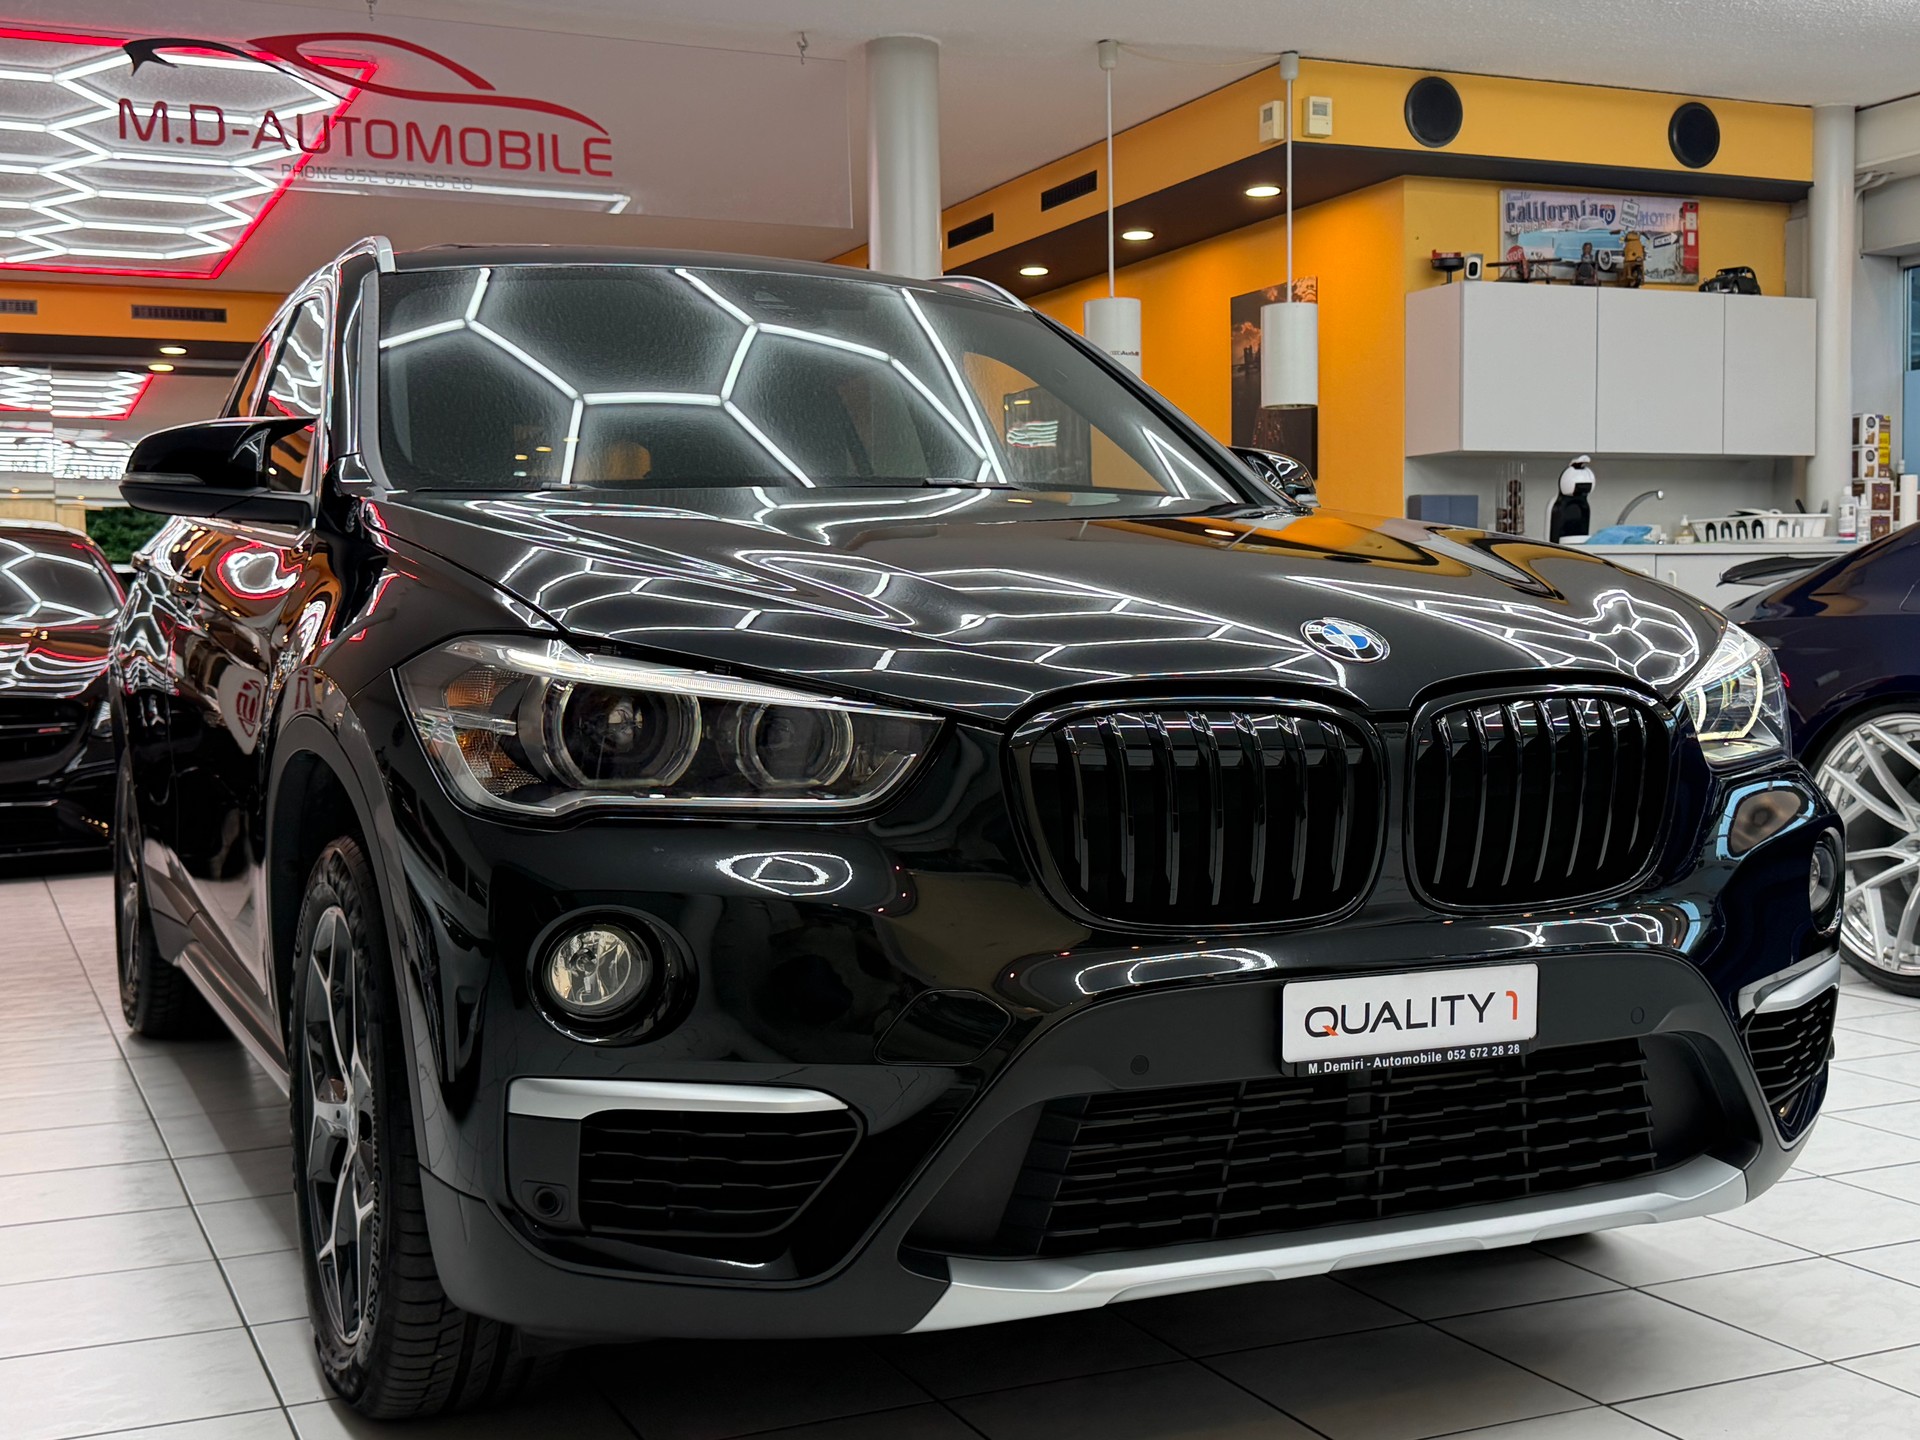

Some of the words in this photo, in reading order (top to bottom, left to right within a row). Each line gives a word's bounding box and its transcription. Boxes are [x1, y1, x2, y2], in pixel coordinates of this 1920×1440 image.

[118, 98, 613, 177] M.D-AUTOMOBILE
[281, 163, 338, 181] PHONE
[344, 168, 379, 184] 052
[385, 171, 417, 186] 672
[1505, 199, 1598, 224] California
[1506, 248, 1523, 262] STOP
[1304, 991, 1496, 1038] QUALITY
[1505, 990, 1518, 1021] 1
[1373, 1051, 1442, 1068] Automobile
[1447, 1049, 1466, 1061] 052
[1469, 1047, 1489, 1058] 672
[1491, 1045, 1505, 1057] 28
[1507, 1043, 1520, 1055] 28
